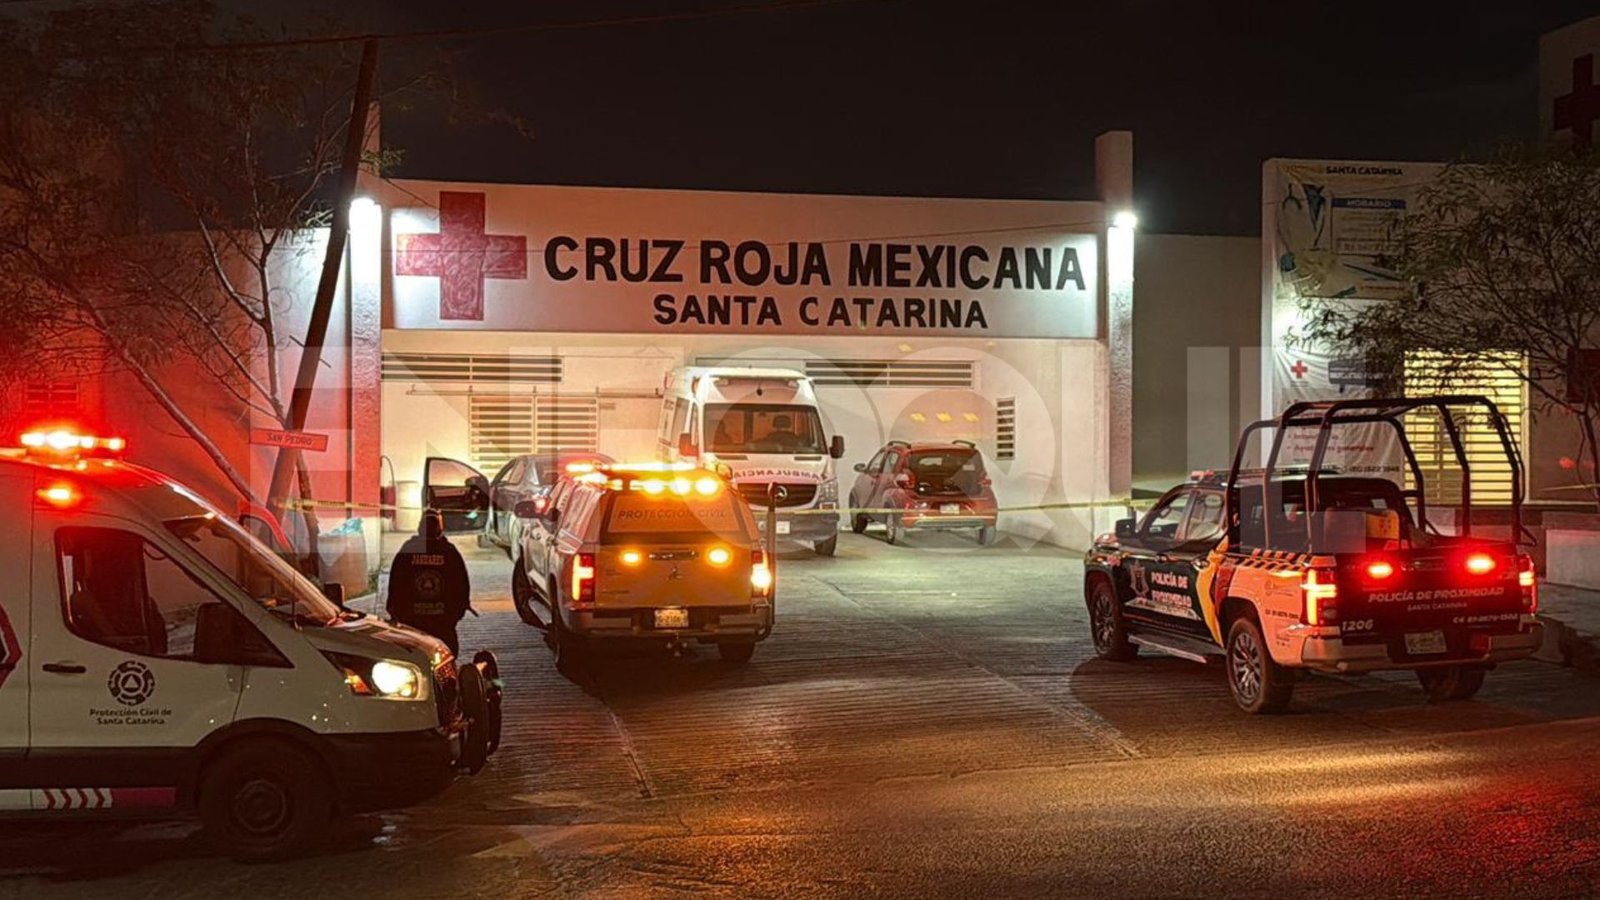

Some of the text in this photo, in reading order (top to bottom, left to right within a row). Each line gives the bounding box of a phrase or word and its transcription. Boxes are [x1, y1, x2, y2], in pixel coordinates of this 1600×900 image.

[544, 236, 1086, 291] CRUZ ROJA MEXICANA
[653, 294, 989, 329] SANTA CATARINA
[266, 432, 313, 445] SAN PEDRO
[699, 509, 726, 518] CIVIL
[1151, 572, 1188, 589] POLICÍA DE
[1368, 586, 1505, 603] POLICÍA DE PROXIMIDAD
[90, 708, 172, 717] Protección Civil de
[97, 717, 165, 725] Santa Catarina
